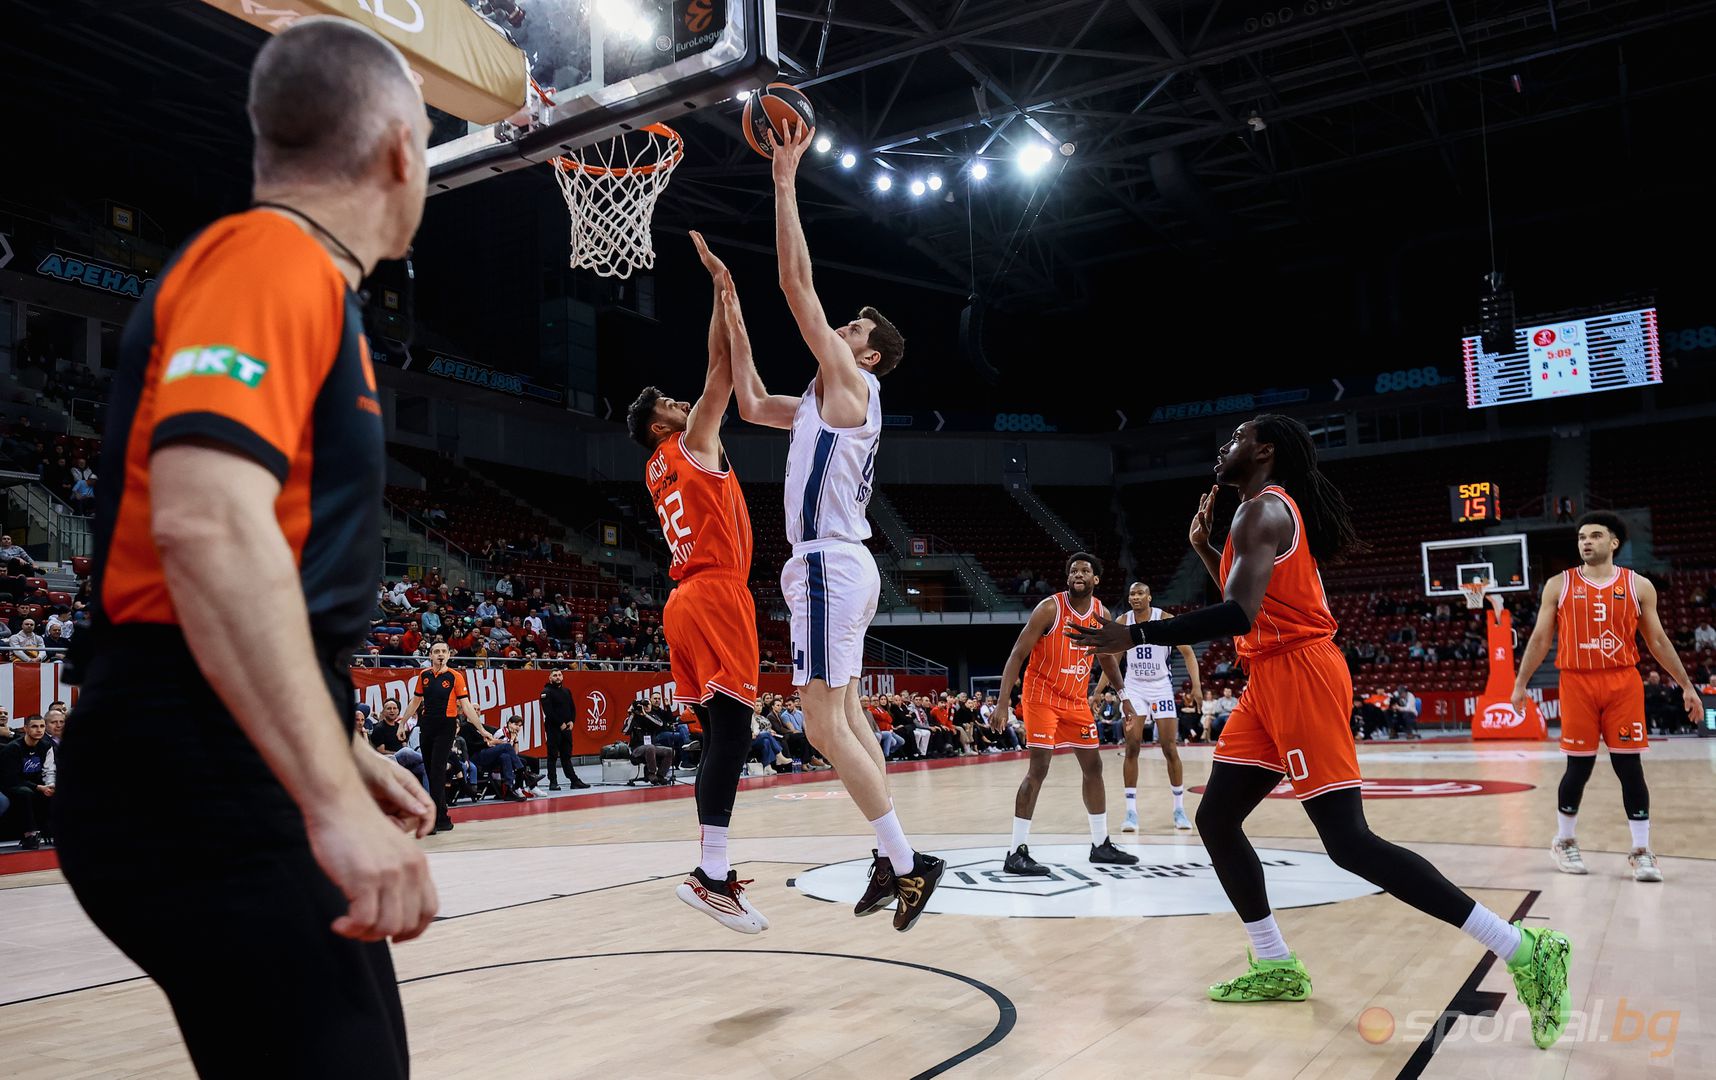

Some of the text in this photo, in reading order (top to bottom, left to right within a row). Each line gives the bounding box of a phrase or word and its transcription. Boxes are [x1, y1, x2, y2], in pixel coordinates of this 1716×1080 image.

[38, 253, 141, 297] АРЕНА
[1547, 347, 1572, 361] 5:09
[167, 348, 266, 386] BKT
[429, 357, 489, 385] АРЕНА
[1150, 401, 1214, 424] АРЕНА
[1458, 482, 1490, 499] 5:09
[1464, 497, 1486, 519] 15
[657, 490, 692, 554] 22
[1593, 602, 1607, 622] 3
[1136, 646, 1152, 660] 88
[1130, 662, 1161, 670] ANADOLU
[1159, 699, 1174, 712] 88
[1632, 722, 1643, 742] 3
[1286, 747, 1309, 781] 0
